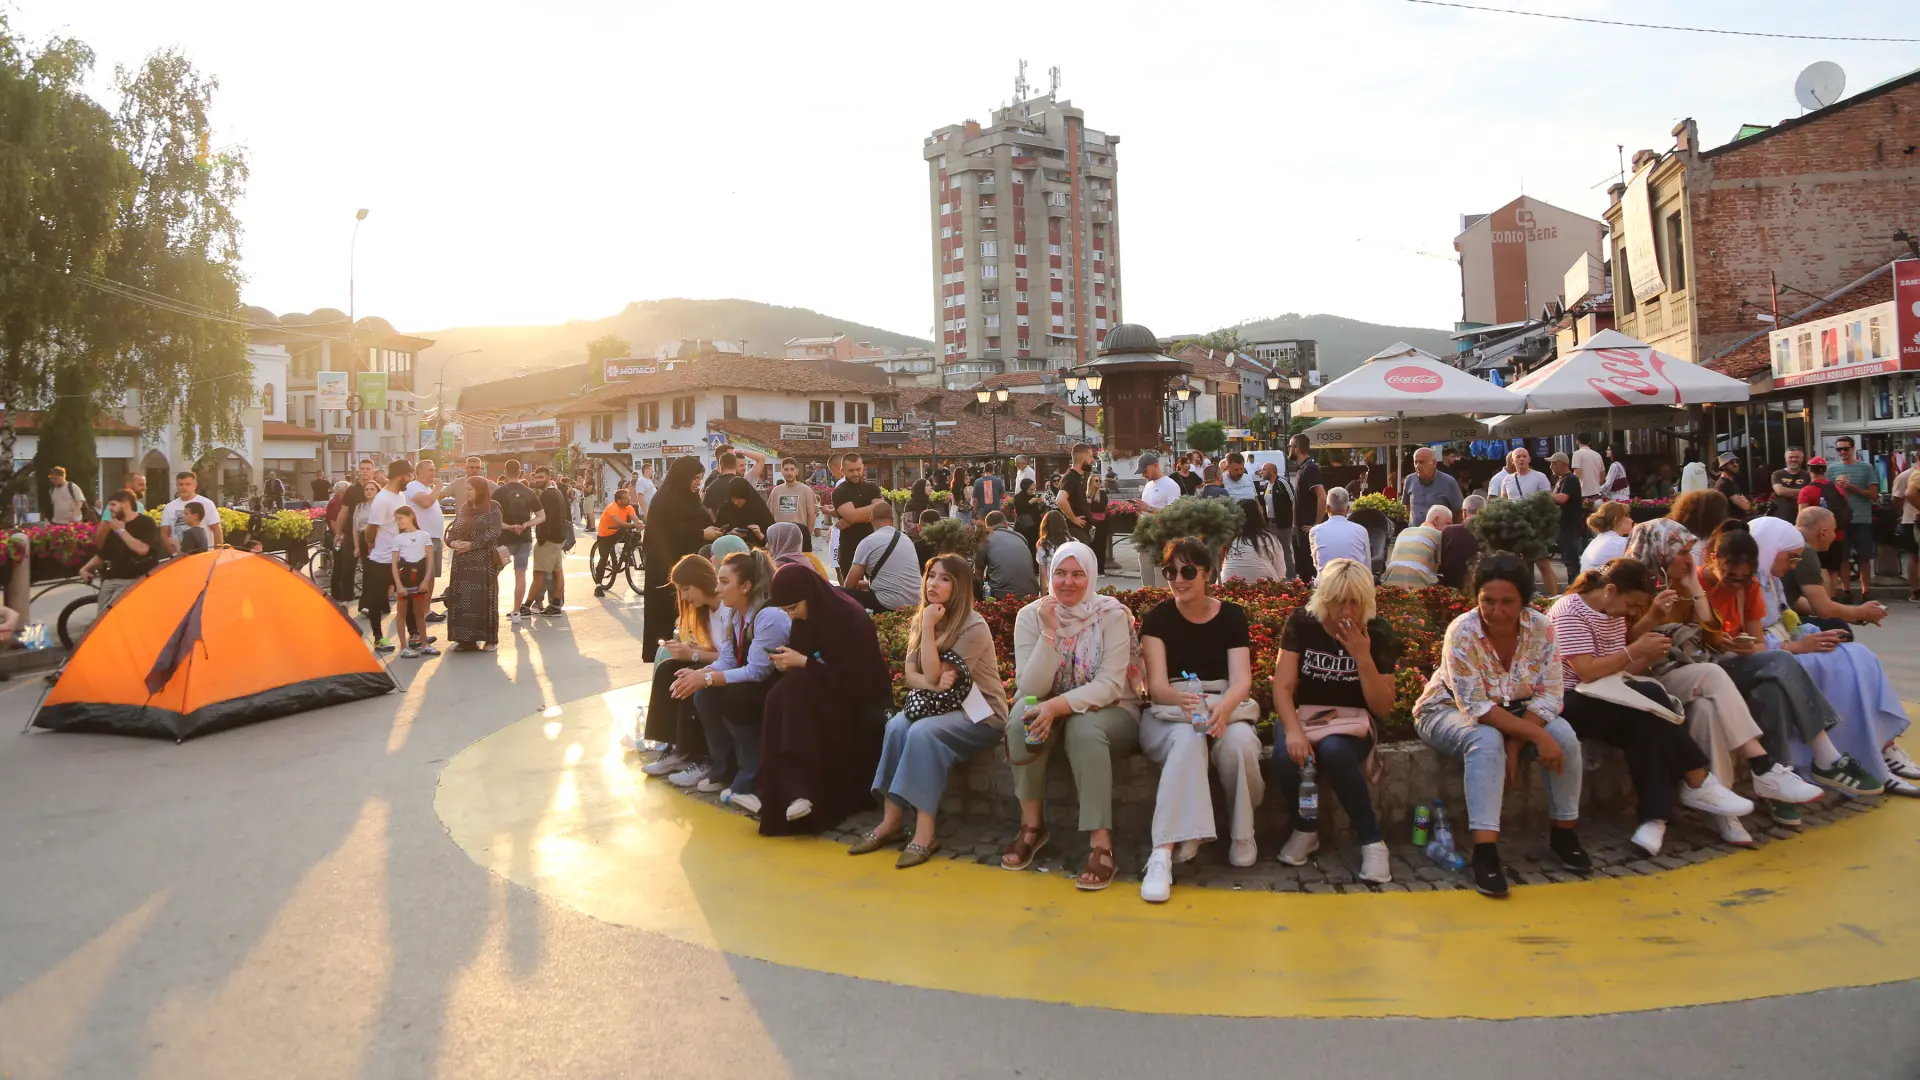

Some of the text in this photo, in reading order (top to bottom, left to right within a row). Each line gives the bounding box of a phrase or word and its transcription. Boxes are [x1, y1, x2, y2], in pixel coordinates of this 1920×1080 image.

[1803, 372, 1826, 384] PRODAJA
[1854, 363, 1883, 375] TELEFONA
[1316, 432, 1343, 441] rosa
[1383, 430, 1410, 440] roa
[1450, 427, 1477, 438] rosa
[335, 435, 349, 443] SPP
[1312, 671, 1343, 682] perfect
